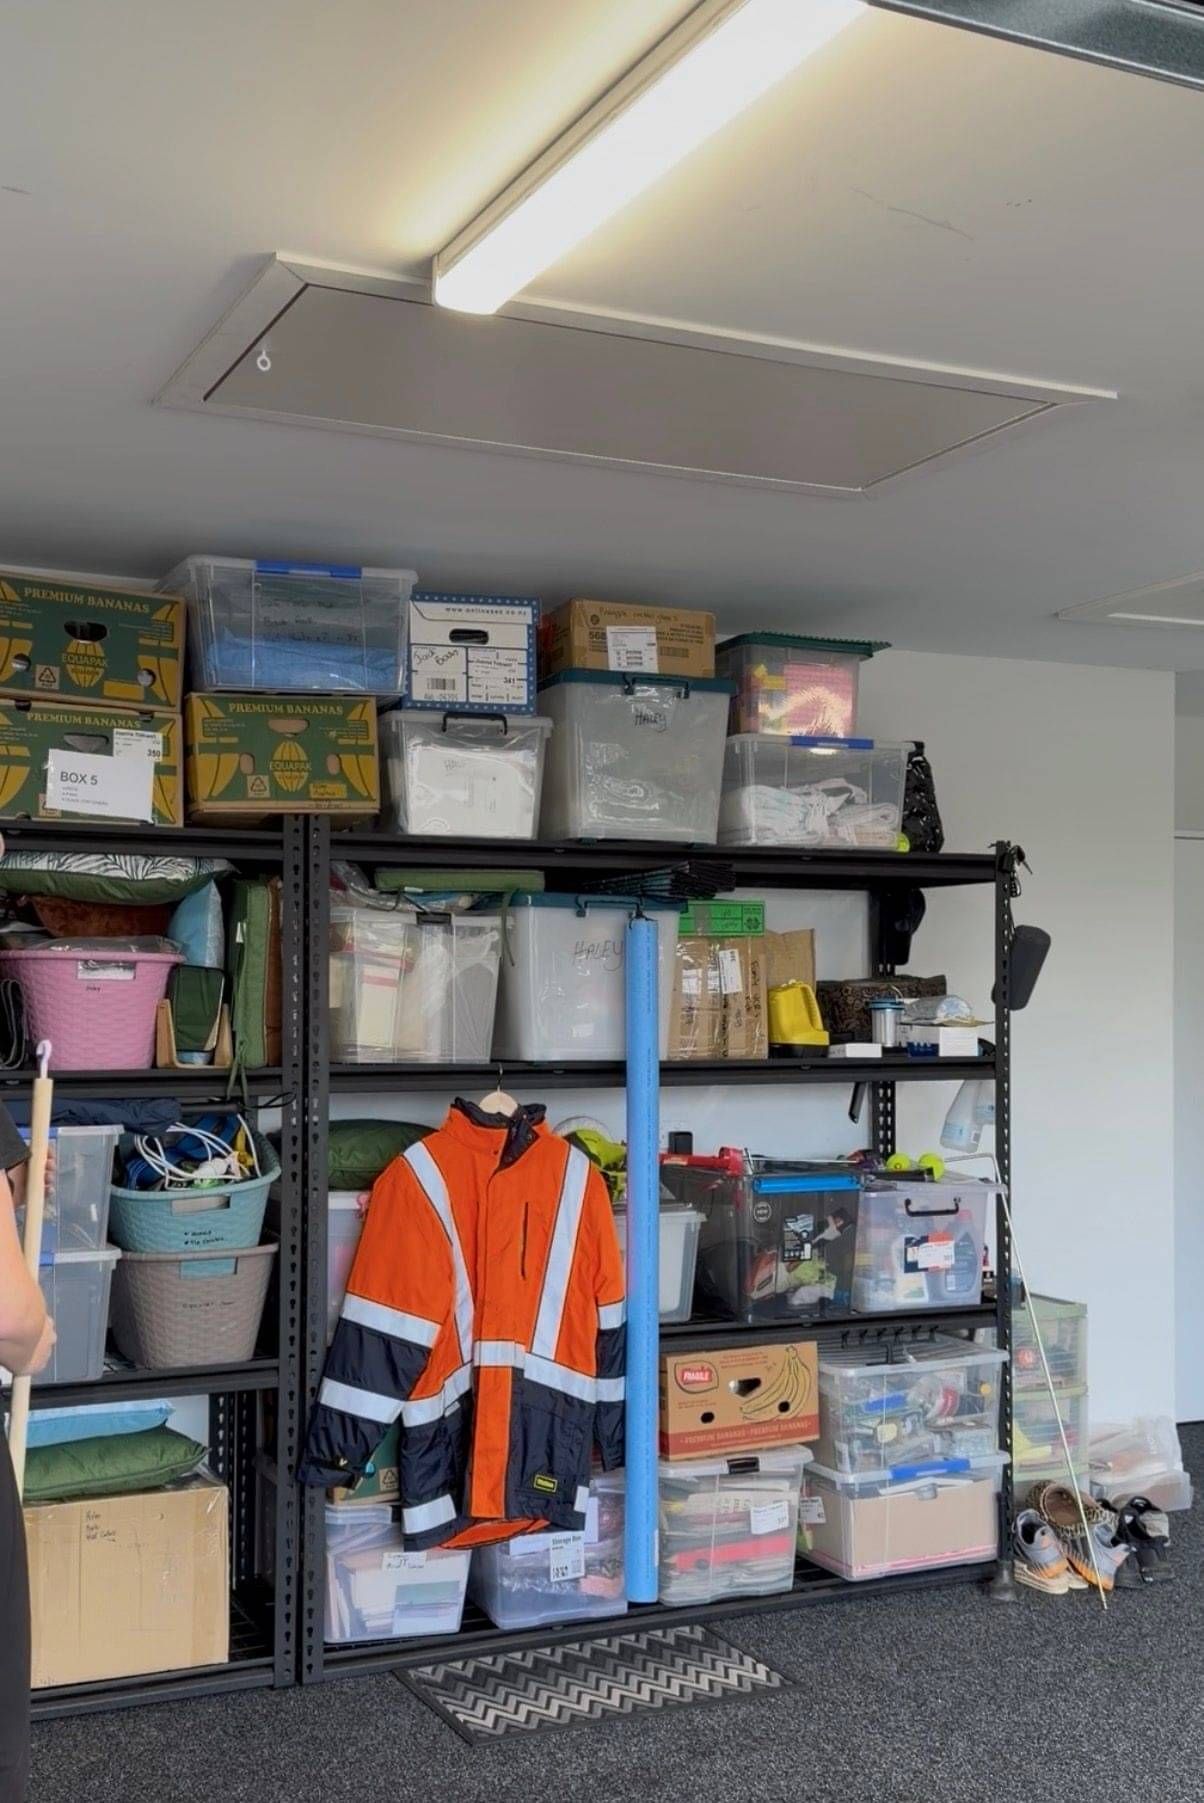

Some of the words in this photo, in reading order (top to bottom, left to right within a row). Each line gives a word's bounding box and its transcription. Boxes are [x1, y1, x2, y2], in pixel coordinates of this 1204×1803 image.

[23, 586, 85, 604] PREMIUM
[87, 595, 150, 613] BANANAS
[228, 702, 285, 714] PREMIUM
[286, 703, 344, 715] BANANAS
[27, 711, 83, 725] PREMIUM
[84, 714, 142, 729] BANANAS
[60, 770, 87, 785] BOX
[90, 775, 98, 786] 5
